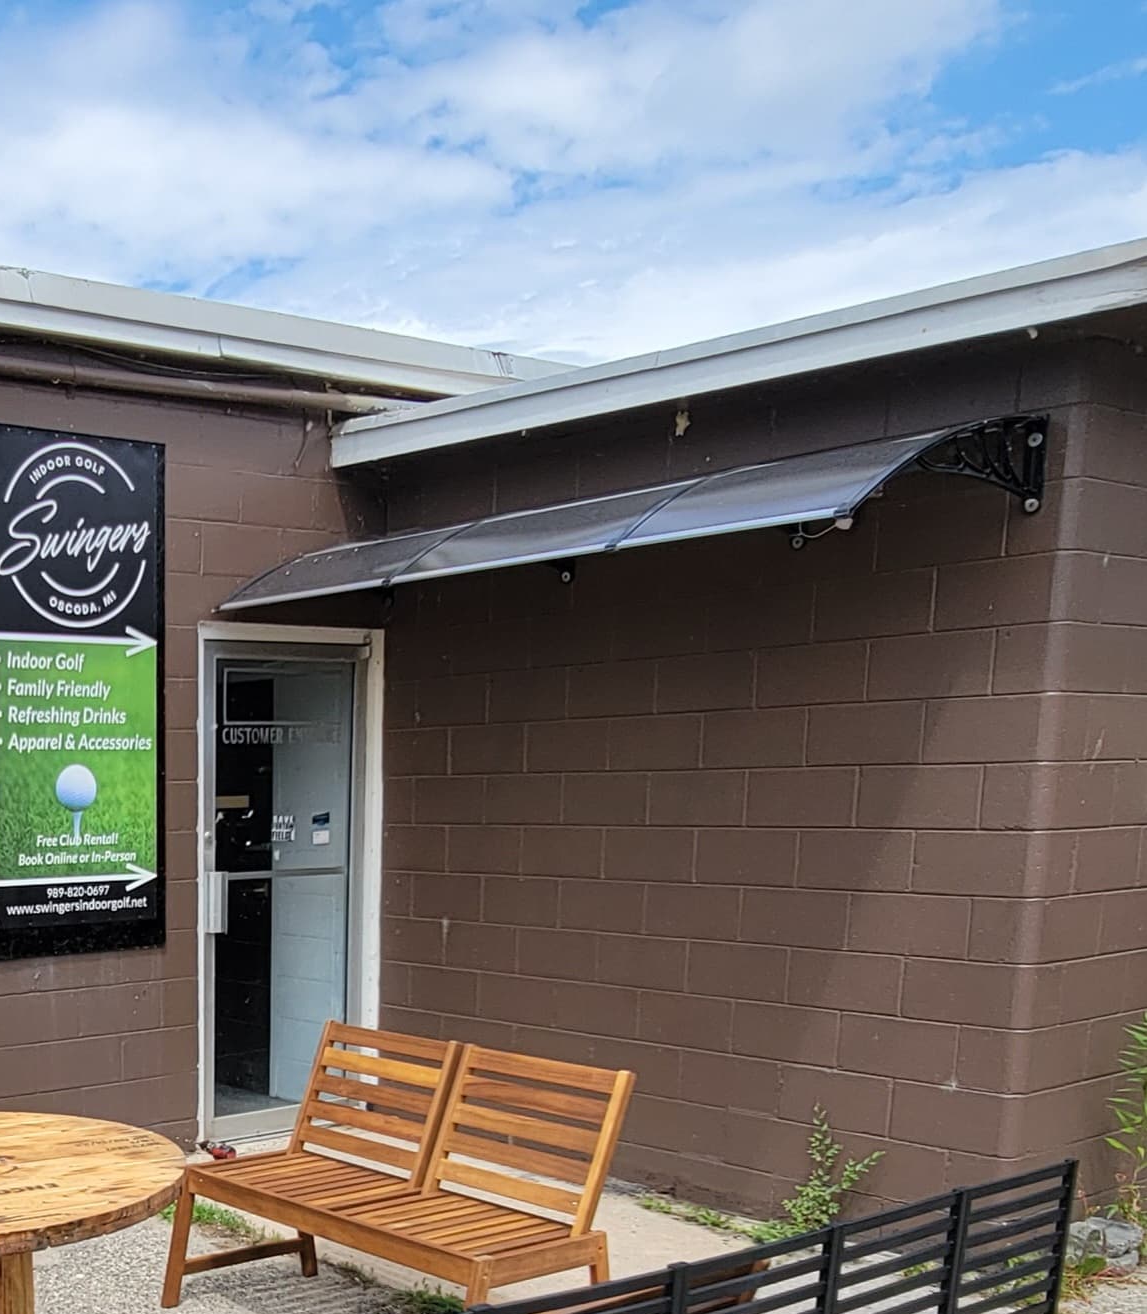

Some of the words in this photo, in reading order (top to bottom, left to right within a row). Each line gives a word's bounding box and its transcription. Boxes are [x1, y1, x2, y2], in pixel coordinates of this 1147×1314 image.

[29, 455, 71, 484] INDOOR
[75, 456, 106, 476] GOLF
[49, 596, 101, 615] OSCODA,
[103, 590, 118, 608] MI
[7, 651, 53, 670] Indoor
[55, 652, 85, 672] Golf
[7, 678, 54, 700] Family
[57, 680, 111, 701] Friendly
[8, 706, 80, 727] Refreshing
[83, 707, 126, 725] Drinks
[7, 732, 63, 753] Apparel
[65, 734, 75, 750] &
[78, 733, 152, 751] Accessories
[222, 726, 283, 745] CUSTOMER
[36, 834, 58, 848] Free
[59, 833, 82, 847] Club
[84, 833, 119, 846] Rental!
[18, 853, 43, 866] Book
[45, 852, 78, 865] Online
[79, 854, 89, 863] or
[91, 851, 136, 863] In-Person
[47, 885, 110, 899] 989-820-0697
[6, 896, 148, 916] www.swingersindoorgolf.net
